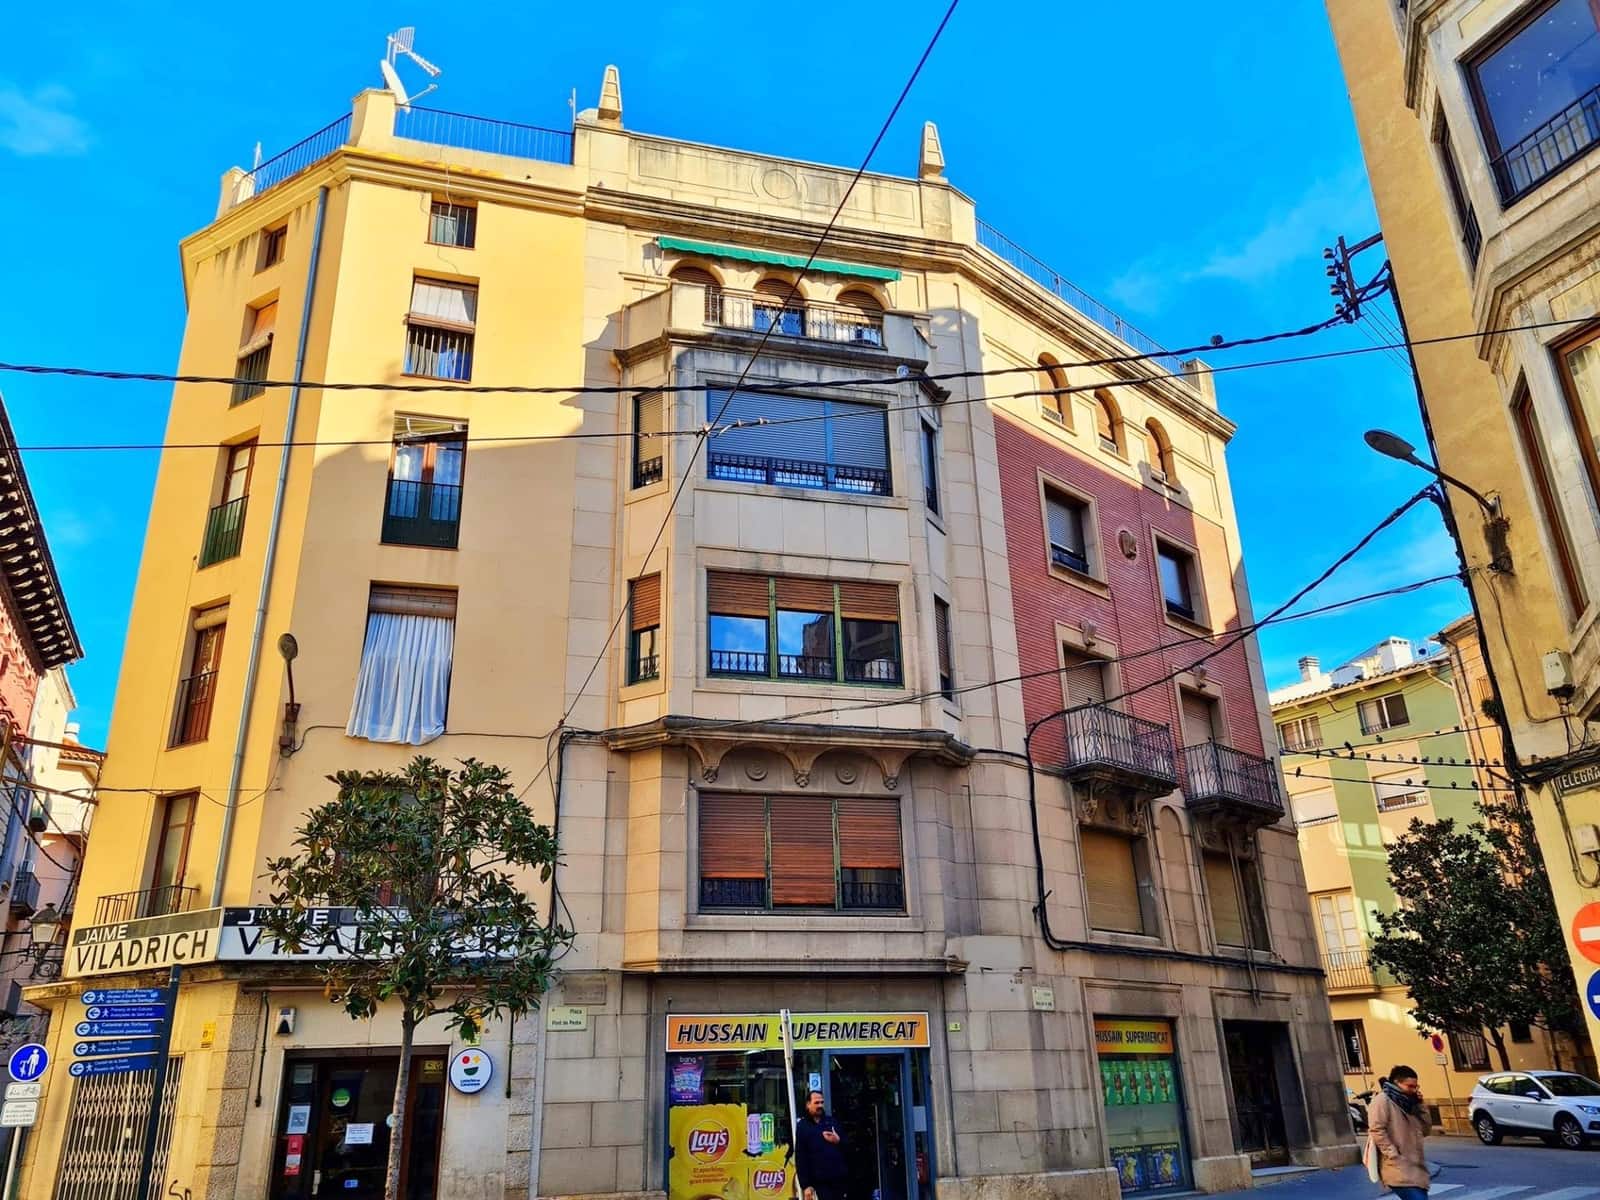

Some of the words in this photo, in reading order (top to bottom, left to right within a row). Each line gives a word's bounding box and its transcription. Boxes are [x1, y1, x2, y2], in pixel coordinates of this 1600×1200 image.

[79, 924, 129, 944] JAIME
[77, 930, 209, 972] VILADRICH
[678, 1023, 768, 1042] HUSSAIN
[691, 1130, 728, 1153] Lay's
[754, 1170, 785, 1189] Lay's
